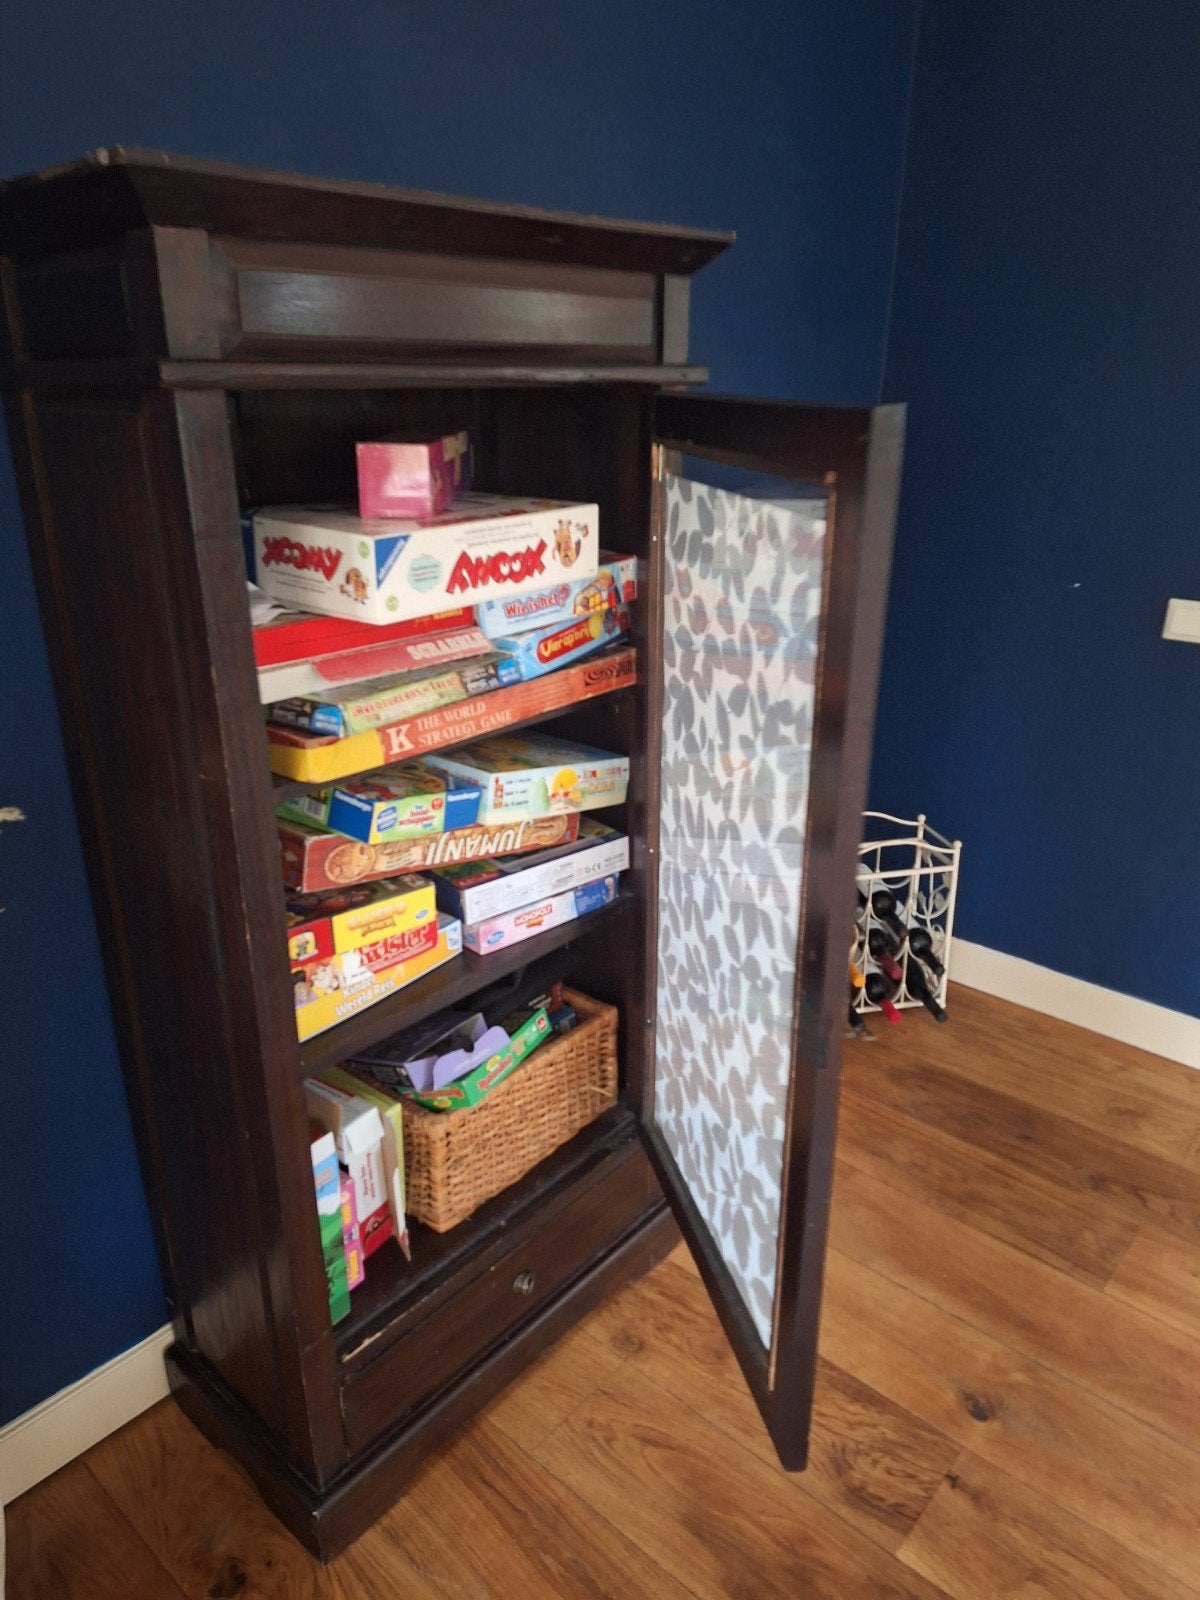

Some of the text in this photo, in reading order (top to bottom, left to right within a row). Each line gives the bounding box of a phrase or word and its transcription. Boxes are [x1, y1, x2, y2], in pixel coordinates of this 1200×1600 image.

[503, 599, 528, 618] Wie
[415, 701, 487, 732] THE WORLD
[418, 709, 513, 747] STRATEGY GAME
[425, 819, 533, 866] JUMANJI
[514, 904, 553, 926] MONOPOLY
